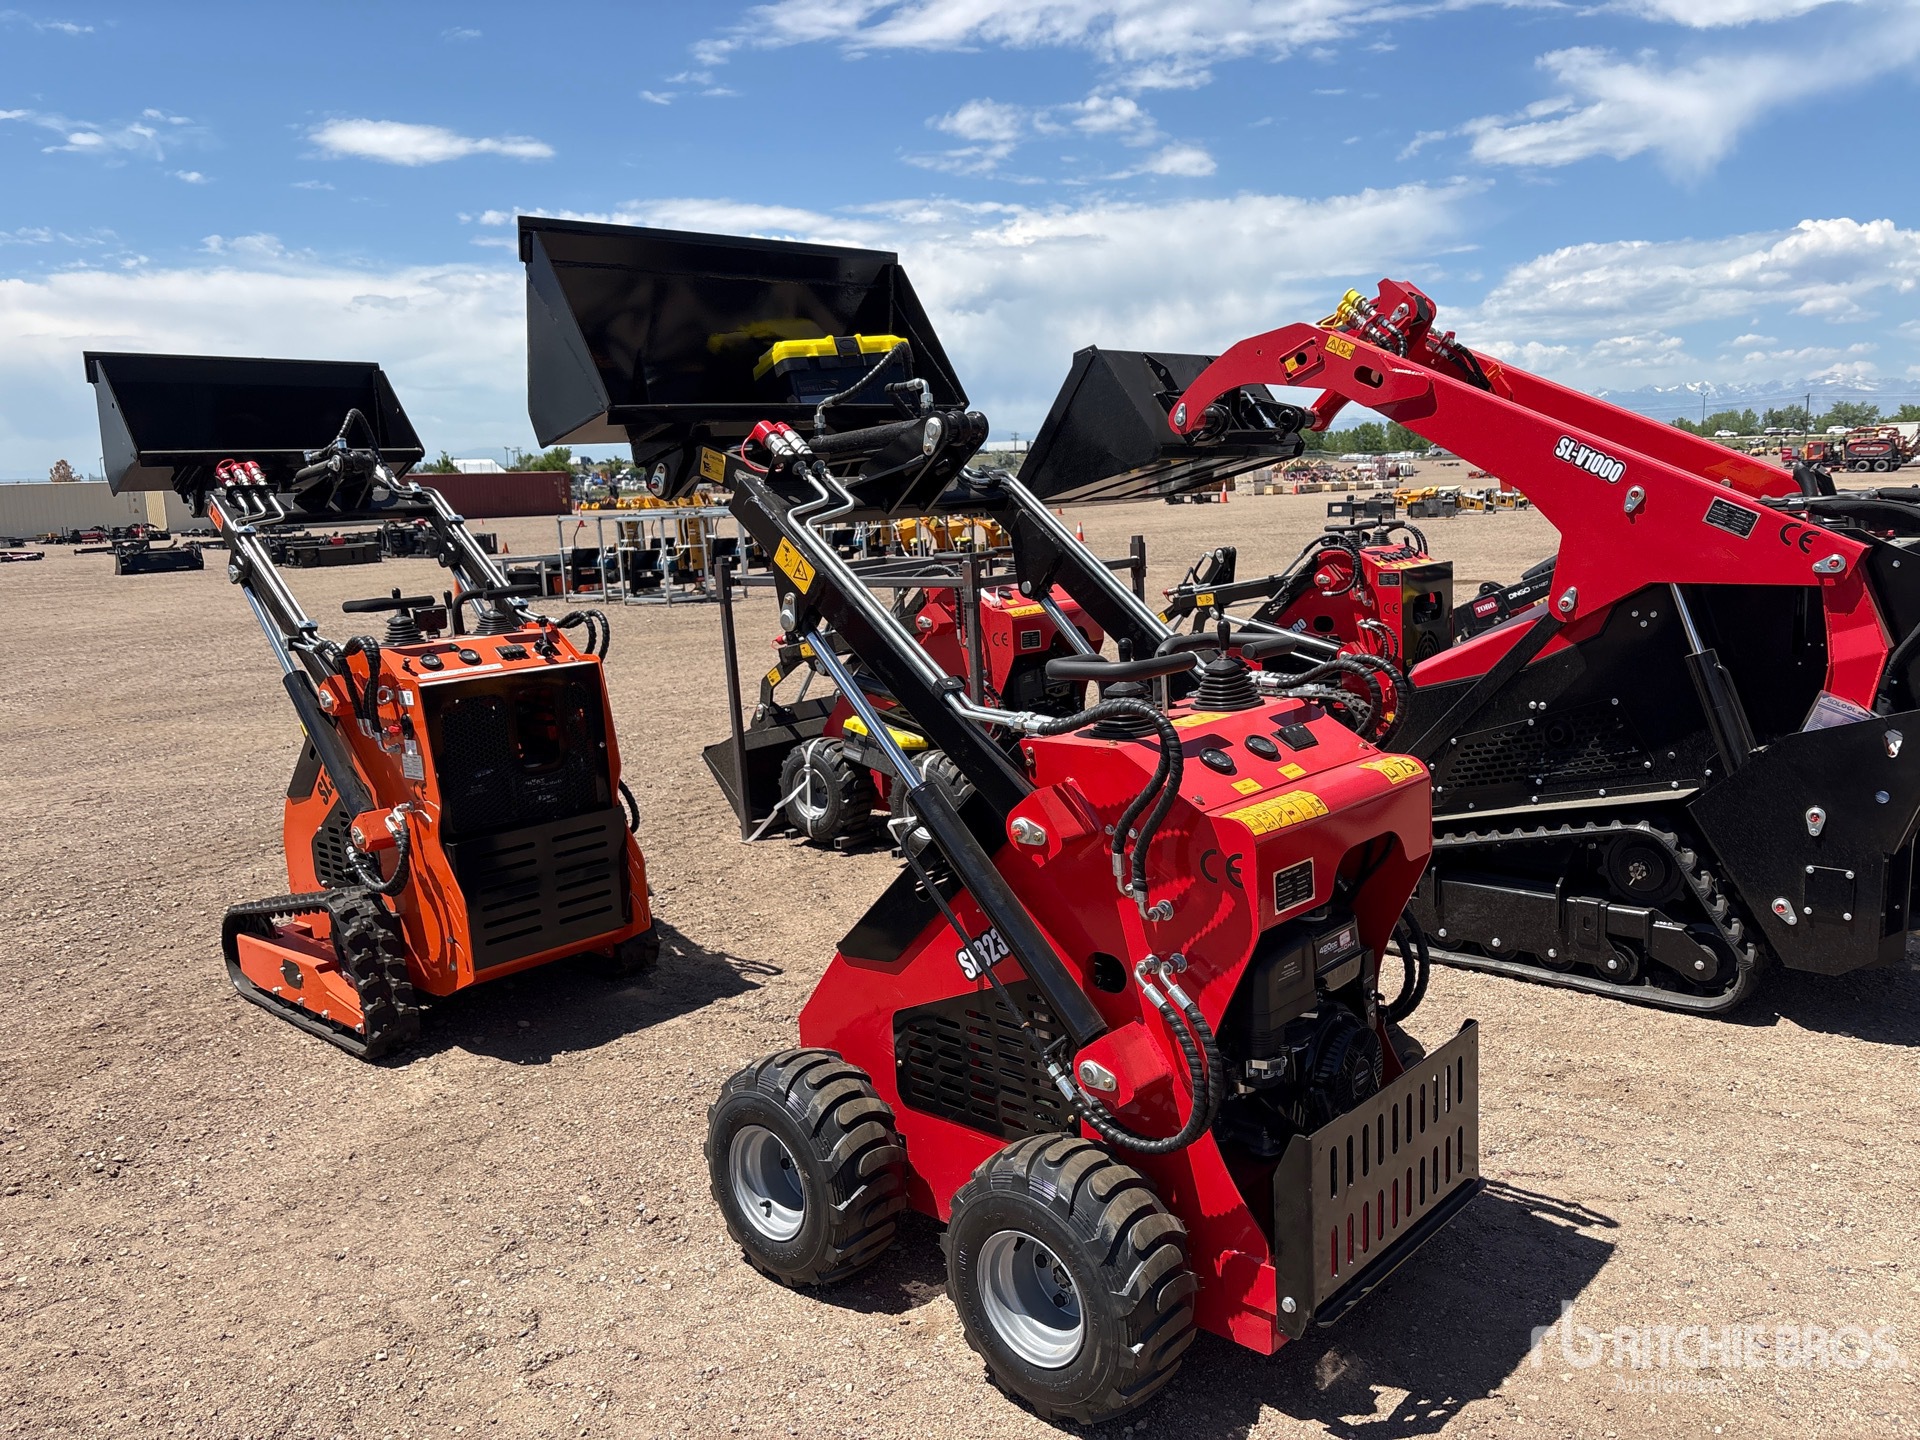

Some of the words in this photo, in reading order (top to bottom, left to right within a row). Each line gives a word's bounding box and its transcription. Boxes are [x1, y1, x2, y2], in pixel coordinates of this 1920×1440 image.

[1554, 436, 1624, 483] SL-V1000
[1780, 522, 1821, 554] CE
[1383, 602, 1399, 615] CE
[1475, 601, 1497, 614] TORO
[992, 632, 1009, 647] CE
[1200, 848, 1244, 889] CE
